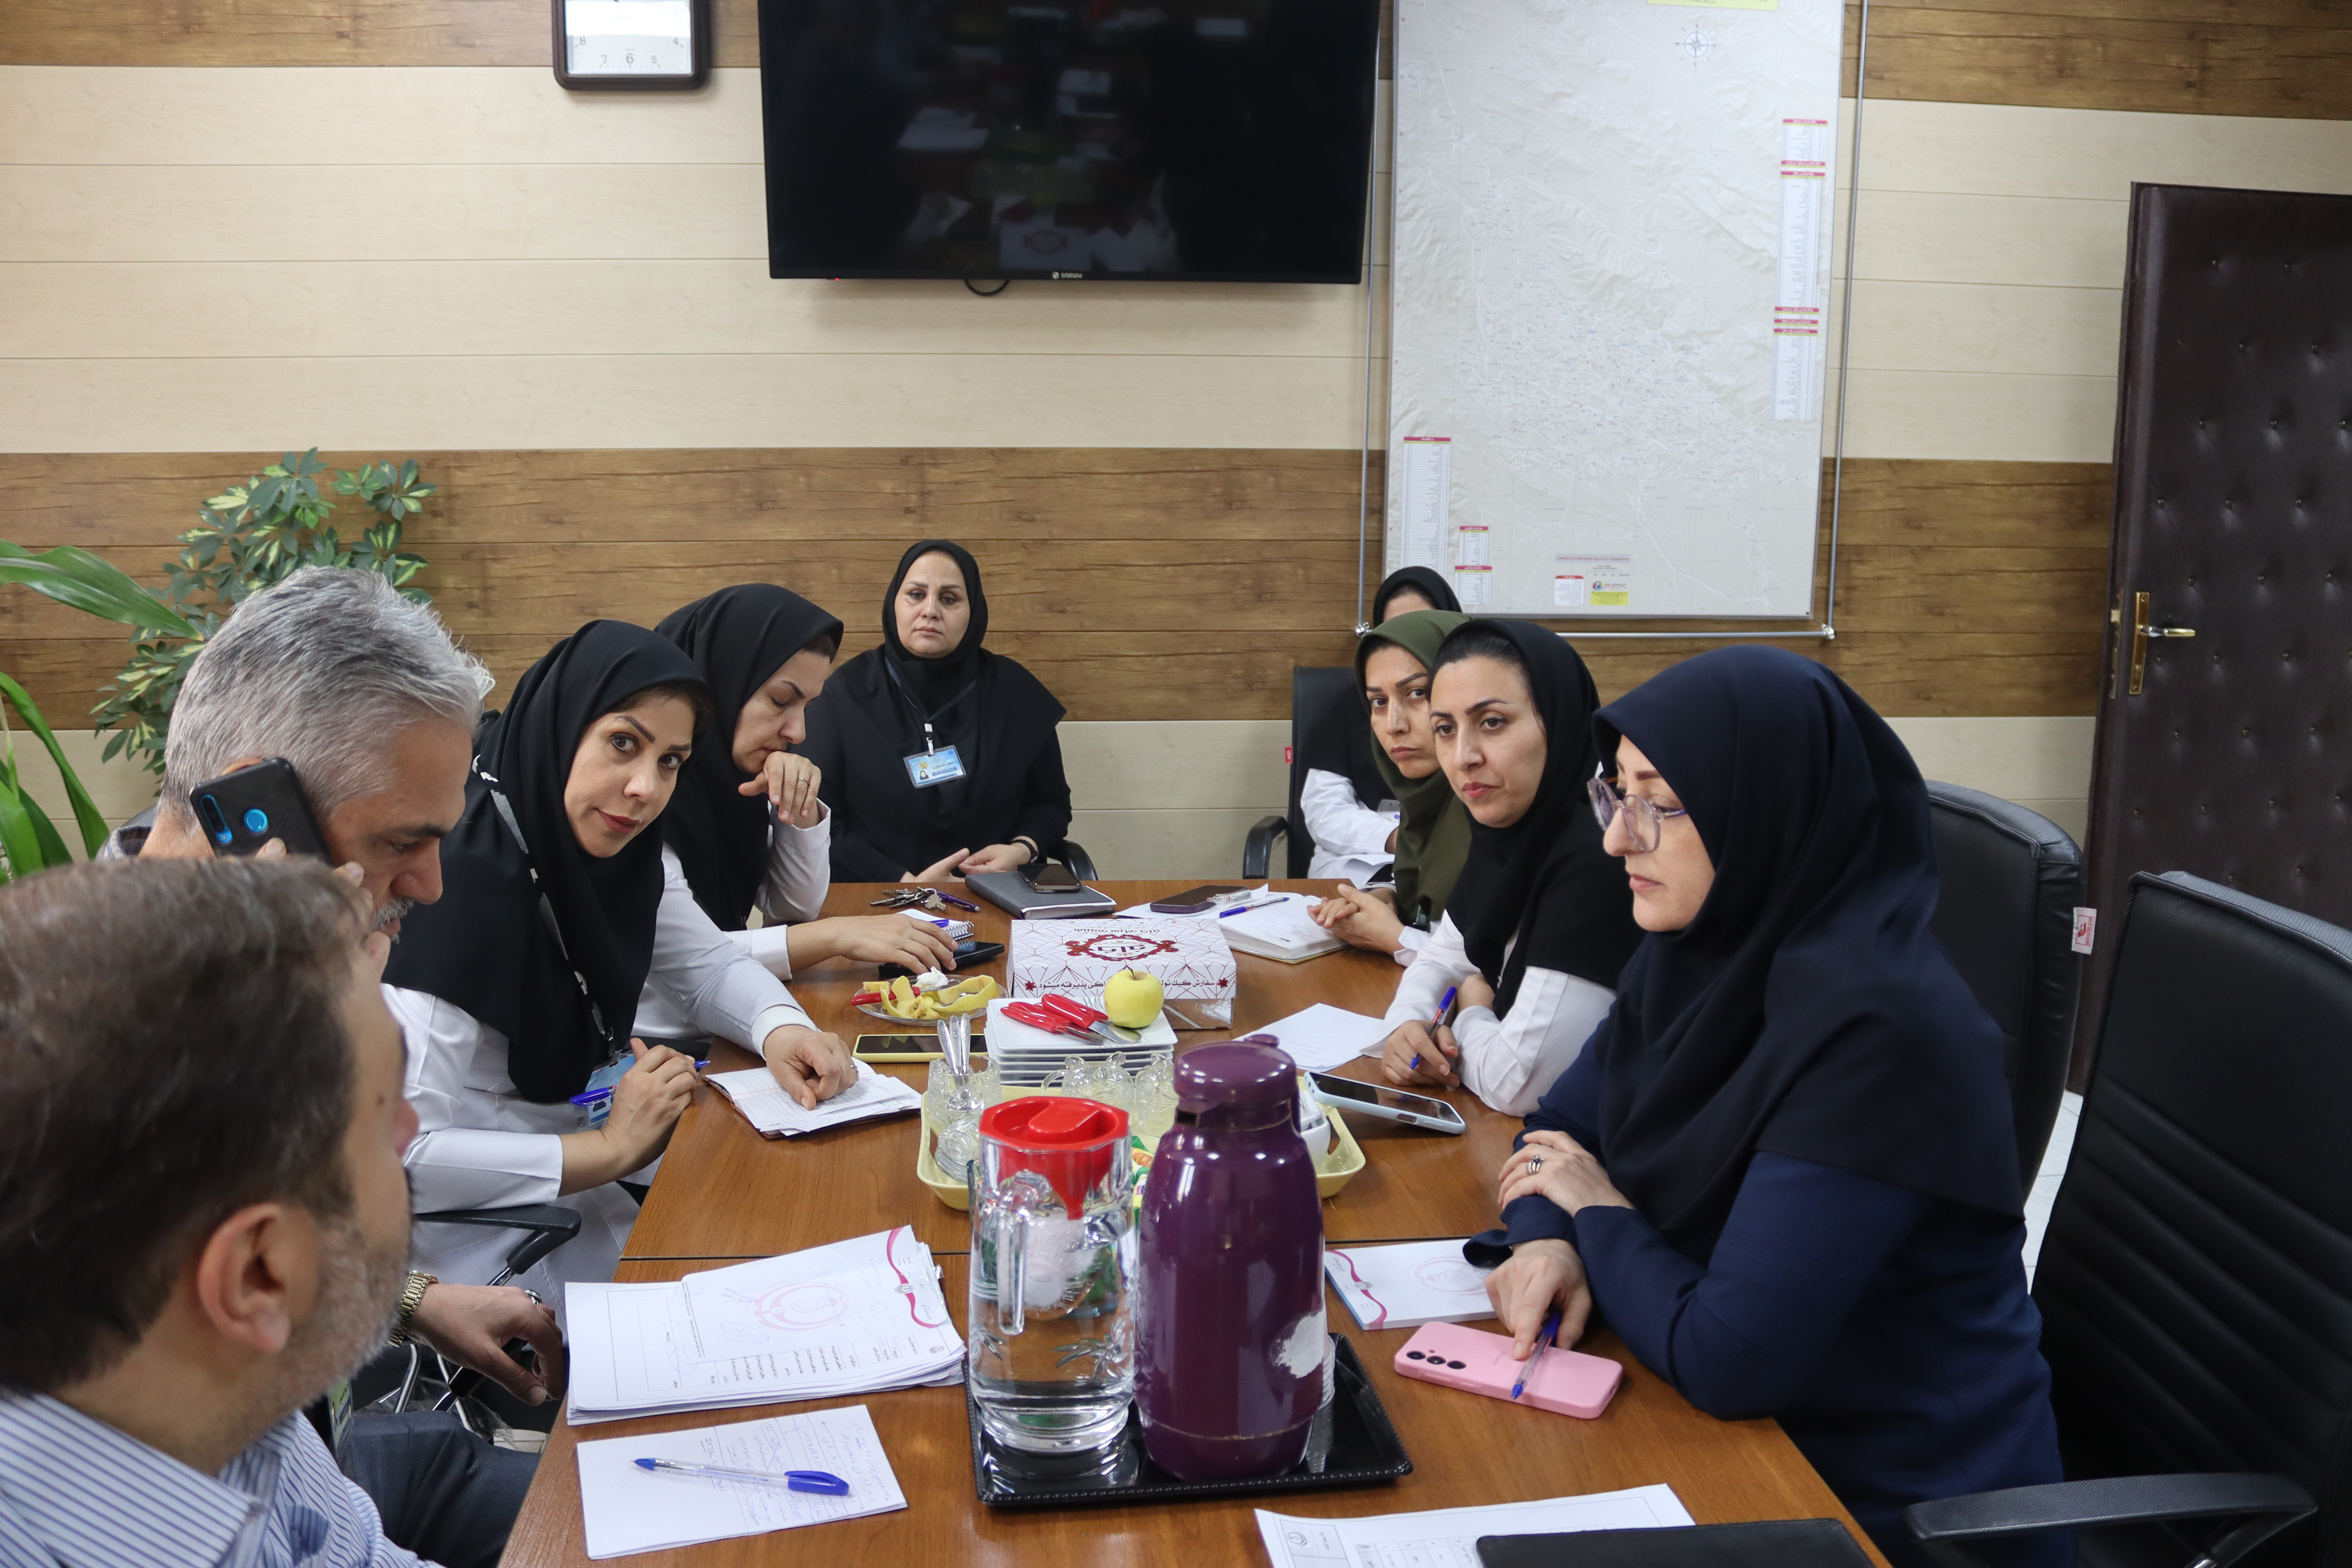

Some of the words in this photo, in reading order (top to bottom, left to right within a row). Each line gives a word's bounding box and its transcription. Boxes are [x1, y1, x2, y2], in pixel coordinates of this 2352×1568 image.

[579, 36, 586, 45] 8
[673, 37, 679, 45] 4
[601, 54, 608, 64] 7
[626, 53, 634, 64] 6
[652, 55, 657, 64] 5
[1039, 982, 1060, 990] میشود
[1061, 980, 1087, 989] پذیرفته
[1192, 979, 1215, 987] سفارش
